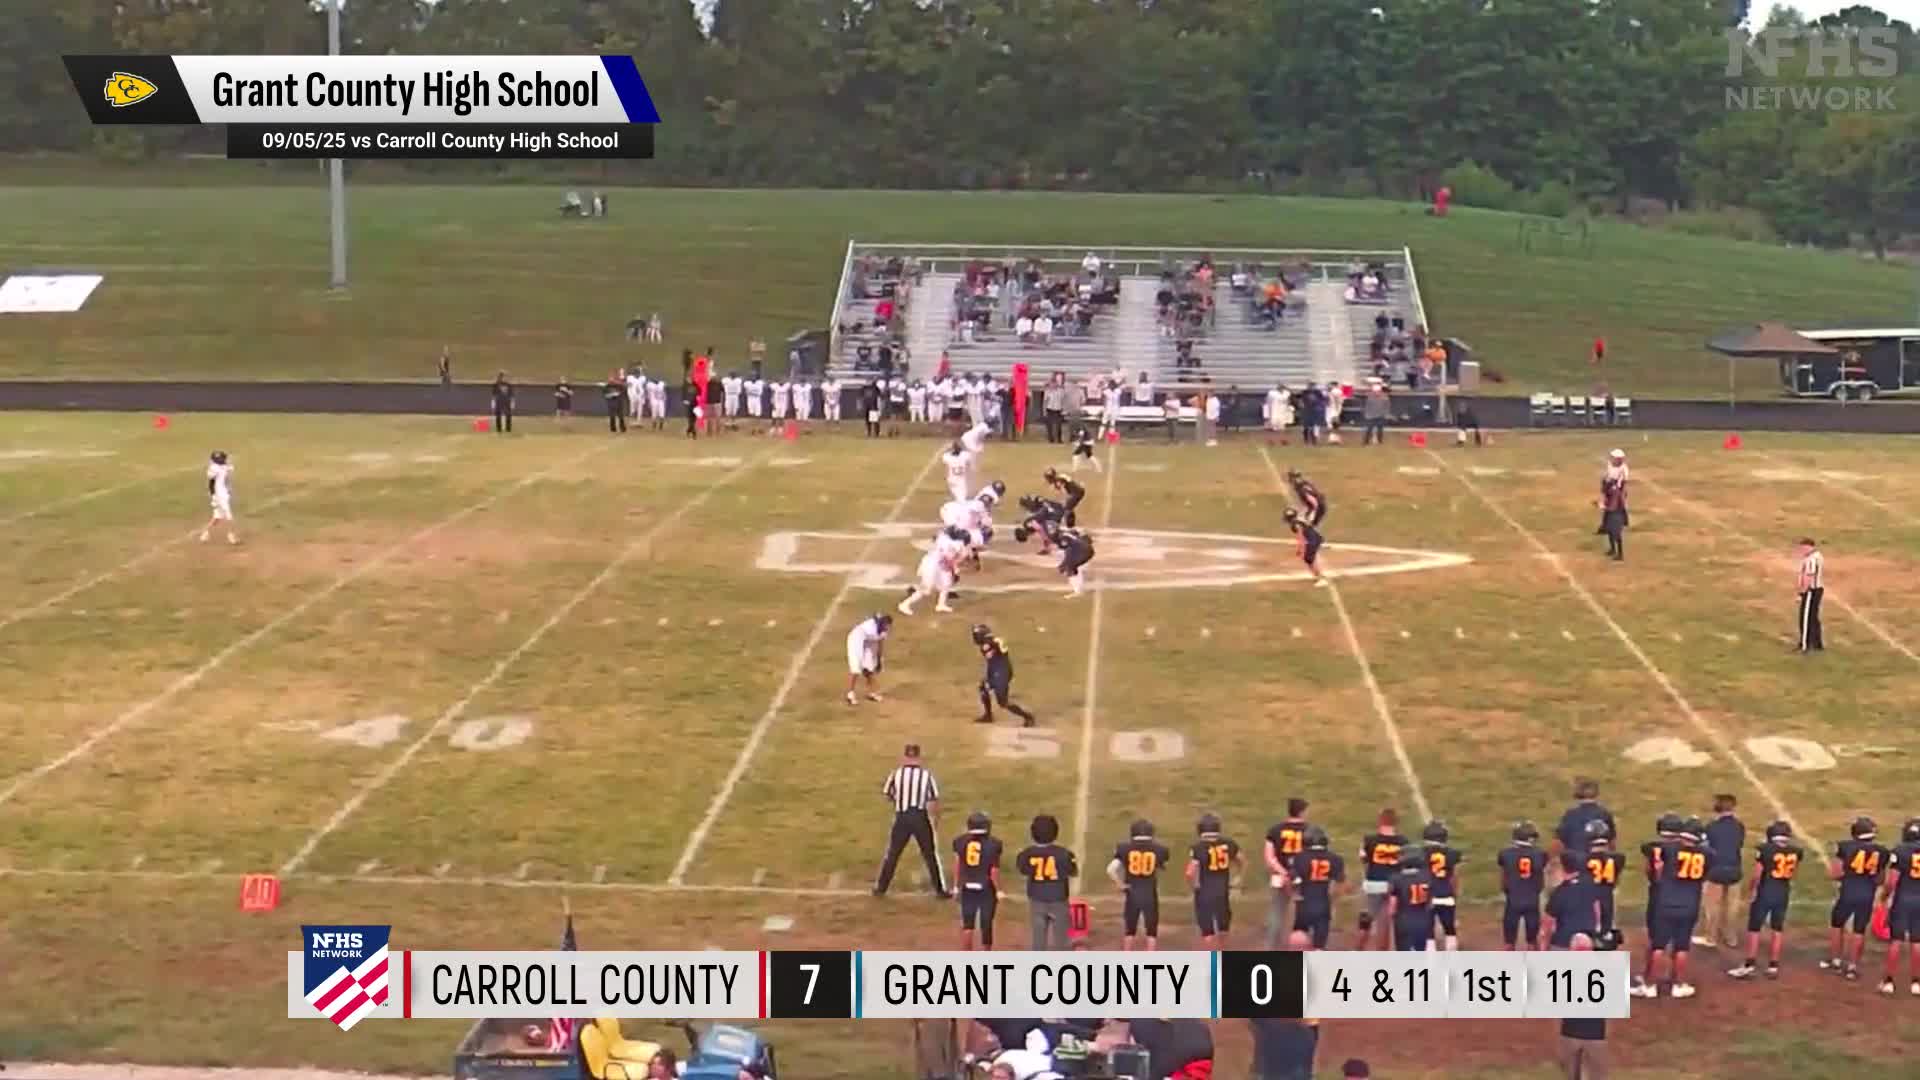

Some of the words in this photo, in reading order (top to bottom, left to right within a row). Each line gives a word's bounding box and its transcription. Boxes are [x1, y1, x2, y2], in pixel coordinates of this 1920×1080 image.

[966, 841, 981, 866] 6
[1128, 850, 1156, 876] 80
[1208, 844, 1229, 871] 15
[1677, 851, 1705, 879] 78
[1850, 850, 1880, 875] 44
[1030, 856, 1058, 881] 74
[1311, 859, 1330, 880] 12
[1587, 858, 1615, 883] 34
